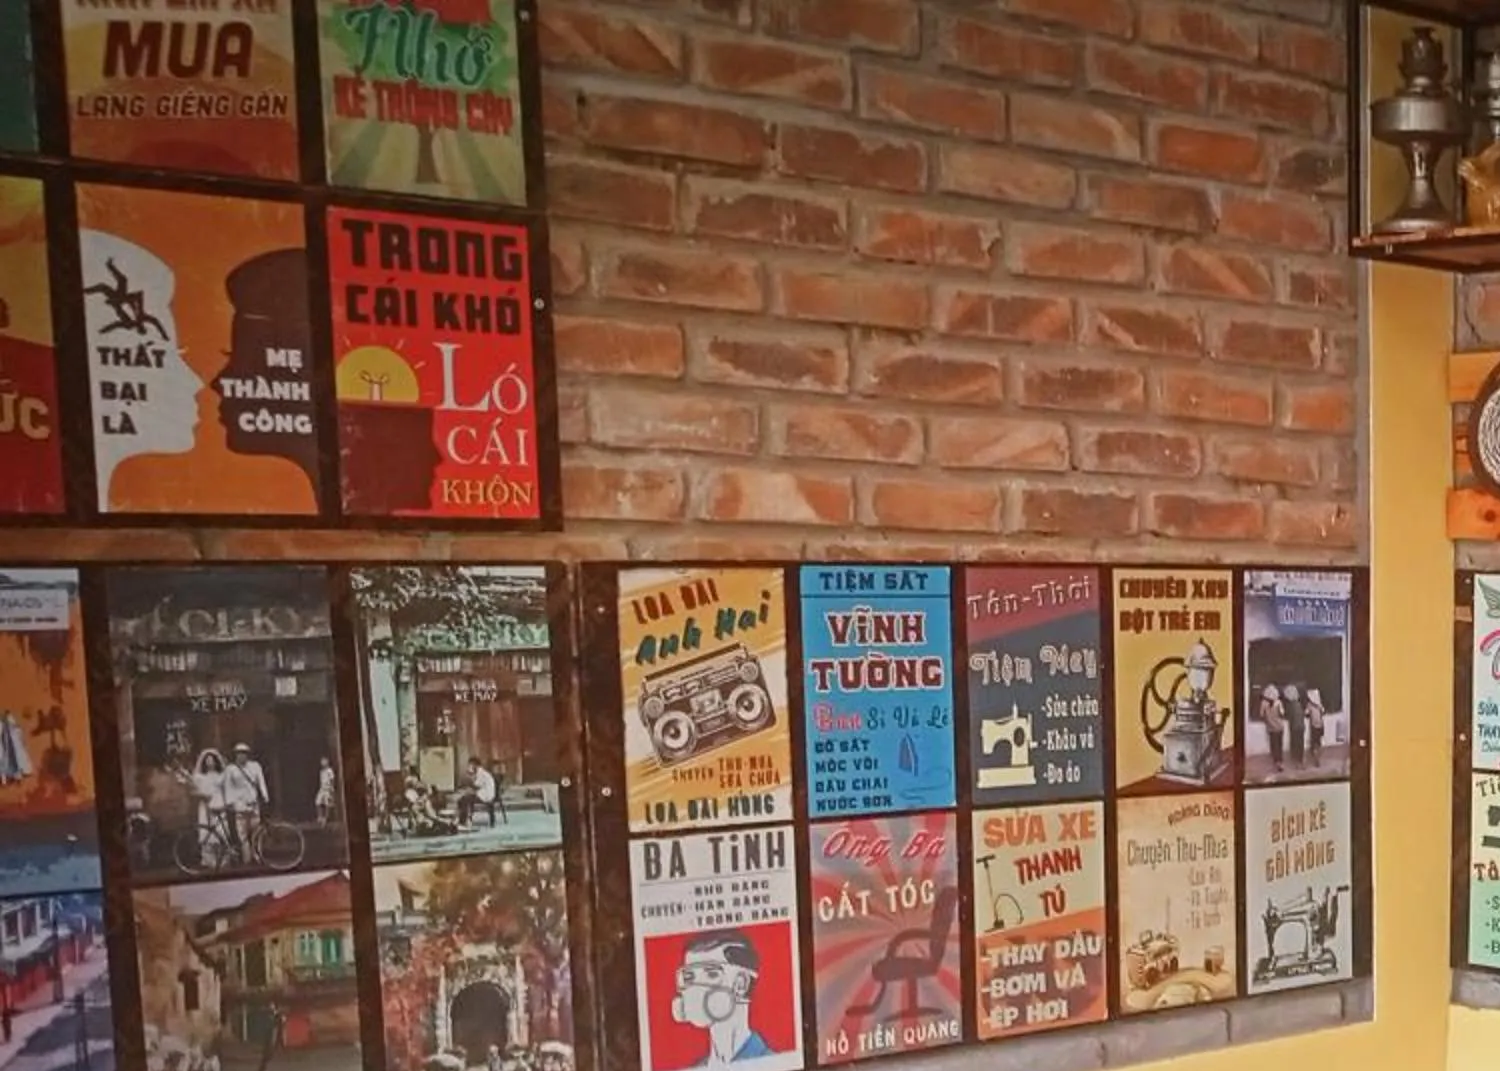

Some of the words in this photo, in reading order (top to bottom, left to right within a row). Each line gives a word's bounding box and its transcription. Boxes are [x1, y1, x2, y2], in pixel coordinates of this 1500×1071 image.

[103, 20, 254, 79] MUA
[341, 219, 524, 284] TRONG
[346, 280, 418, 329] CÁI
[433, 283, 522, 336] KHÓ
[102, 407, 138, 435] LÀ
[239, 409, 313, 435] CÔNG
[447, 418, 530, 467] CÁI
[442, 471, 534, 507] KHÔN
[824, 604, 927, 647] VĨNH
[1058, 809, 1097, 842] XE
[643, 839, 687, 880] BA
[1014, 844, 1083, 885] THANH
